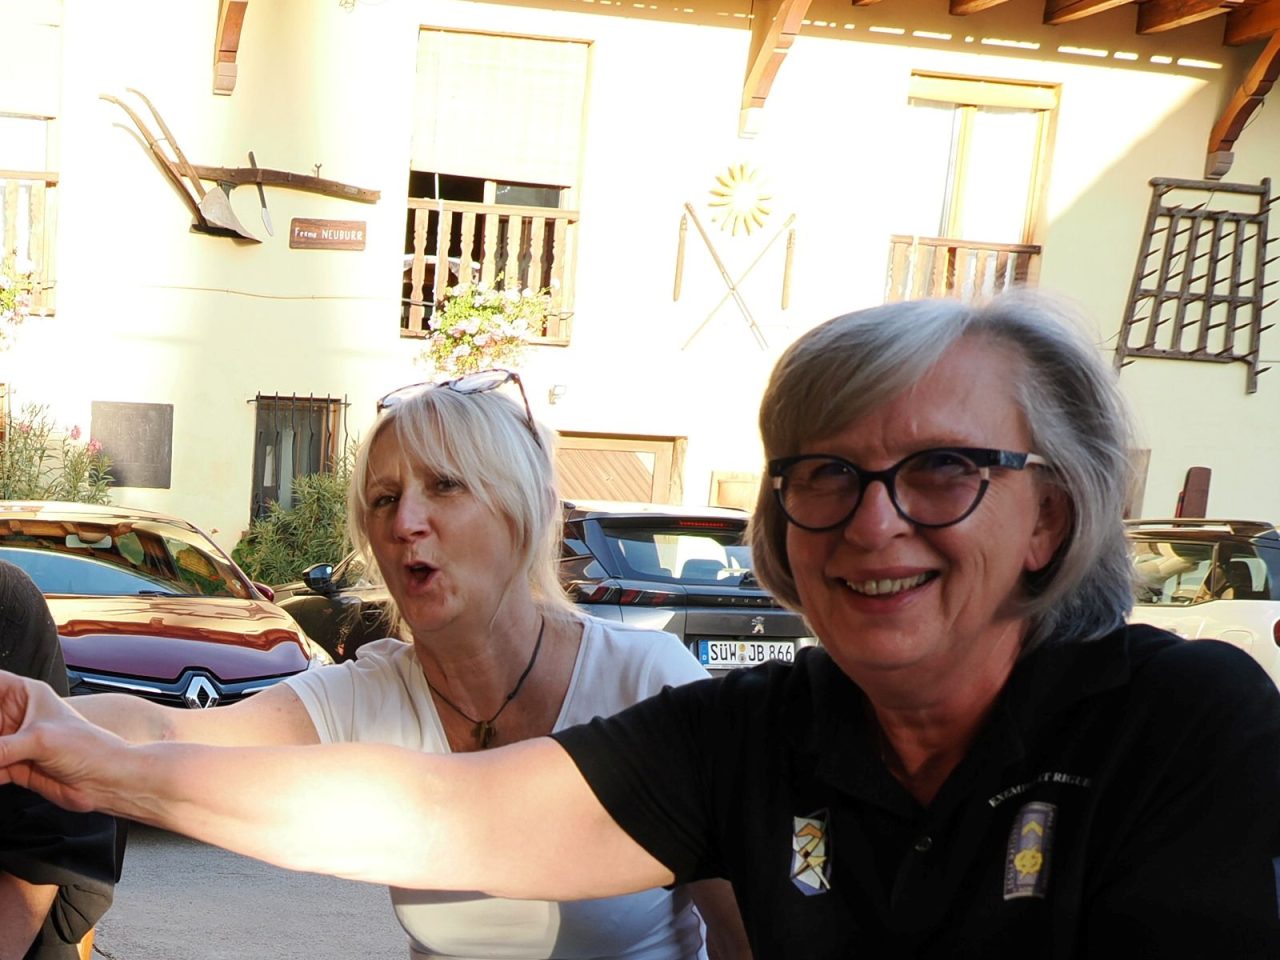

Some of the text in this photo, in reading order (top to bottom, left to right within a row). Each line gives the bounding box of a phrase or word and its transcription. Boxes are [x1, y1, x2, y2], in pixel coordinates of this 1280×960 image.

[711, 643, 792, 662] SÜW JB 866
